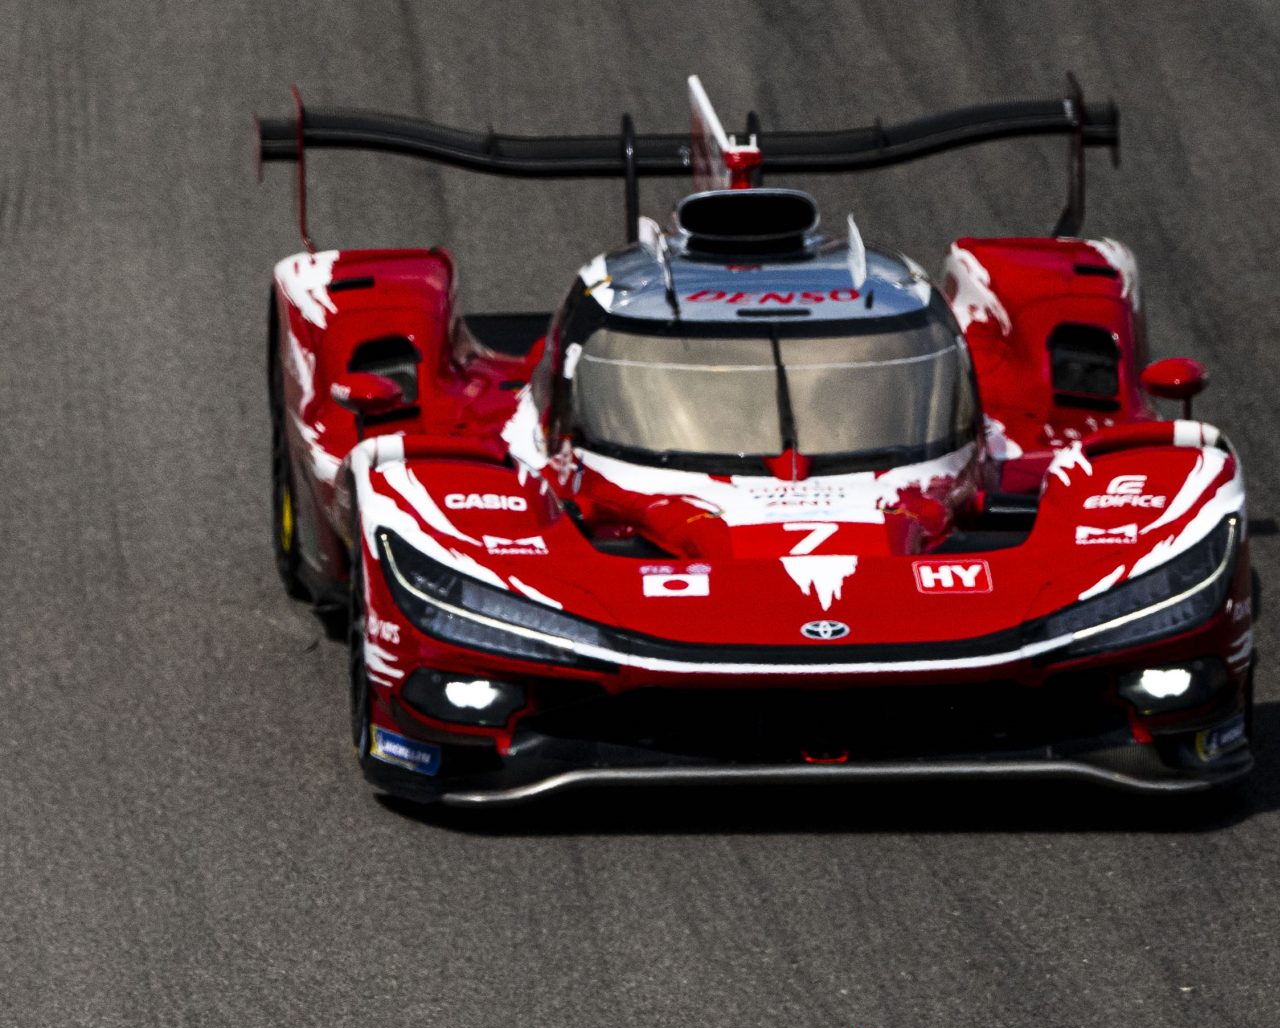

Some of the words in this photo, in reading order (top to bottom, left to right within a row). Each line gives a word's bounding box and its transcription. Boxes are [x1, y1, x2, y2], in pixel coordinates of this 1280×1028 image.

[686, 288, 860, 304] DENSO
[445, 493, 528, 512] CASIO
[1083, 494, 1166, 509] EDIFICE
[783, 522, 839, 555] 7
[919, 564, 982, 588] HY
